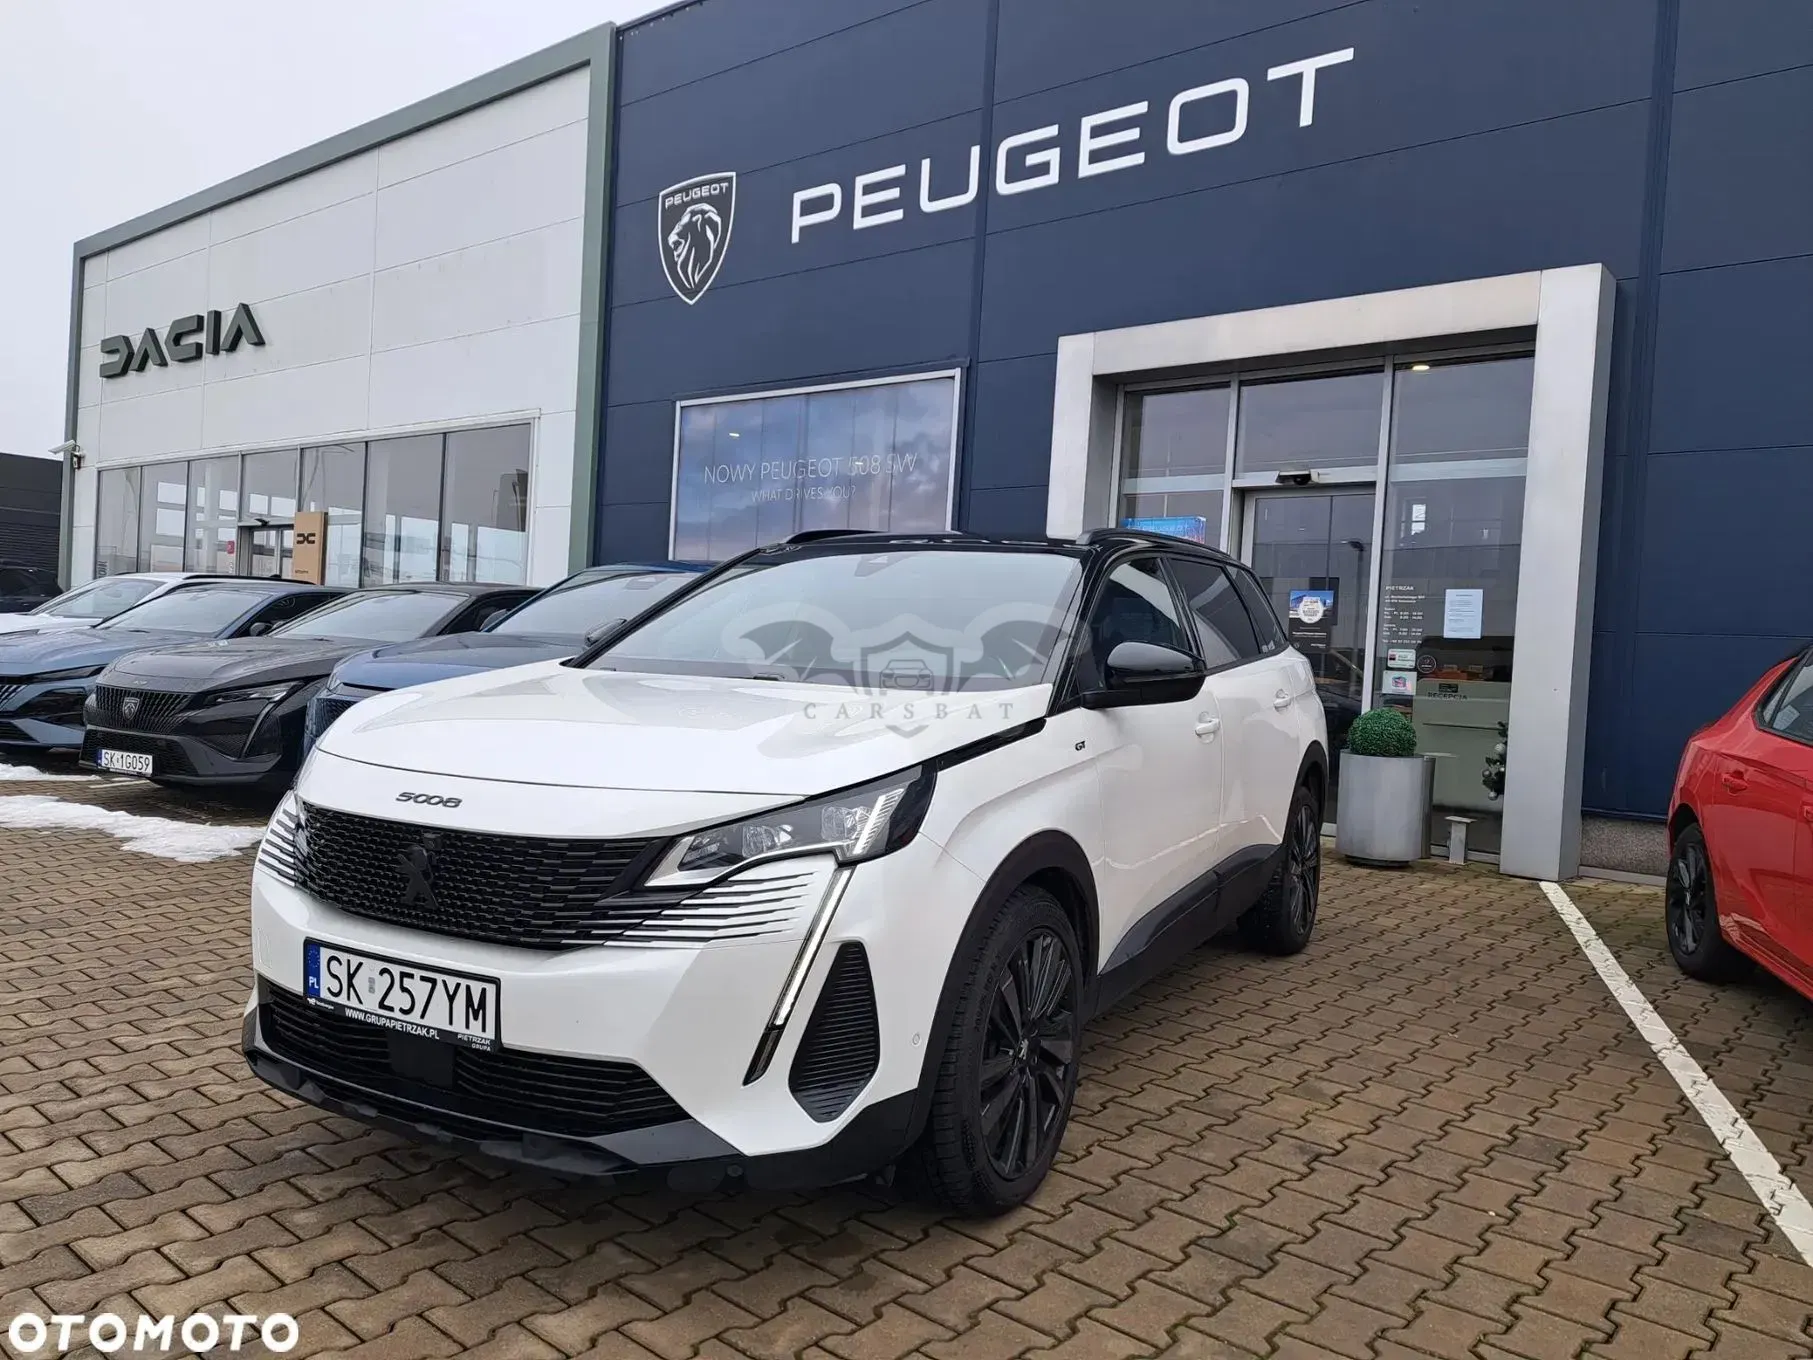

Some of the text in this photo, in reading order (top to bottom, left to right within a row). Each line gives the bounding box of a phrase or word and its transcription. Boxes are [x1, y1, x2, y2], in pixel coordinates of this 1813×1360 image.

[791, 47, 1355, 244] PEUGEOT
[665, 182, 729, 209] PEUGEOT
[100, 302, 266, 379] DACIA
[704, 462, 756, 485] NOWY
[760, 456, 845, 480] PEUGEOT
[885, 452, 918, 475] SW
[751, 485, 856, 502] WHAT DRIVES YOU?
[103, 751, 116, 768] SK
[120, 753, 151, 772] 1G059
[395, 791, 463, 808] 5008
[308, 976, 320, 989] PL
[326, 955, 488, 1034] SK 257YM
[344, 1007, 440, 1041] WWW.GRUPAPIETRZAK.PL
[457, 1033, 492, 1046] PIETRZAK
[471, 1043, 492, 1052] GRUPA
